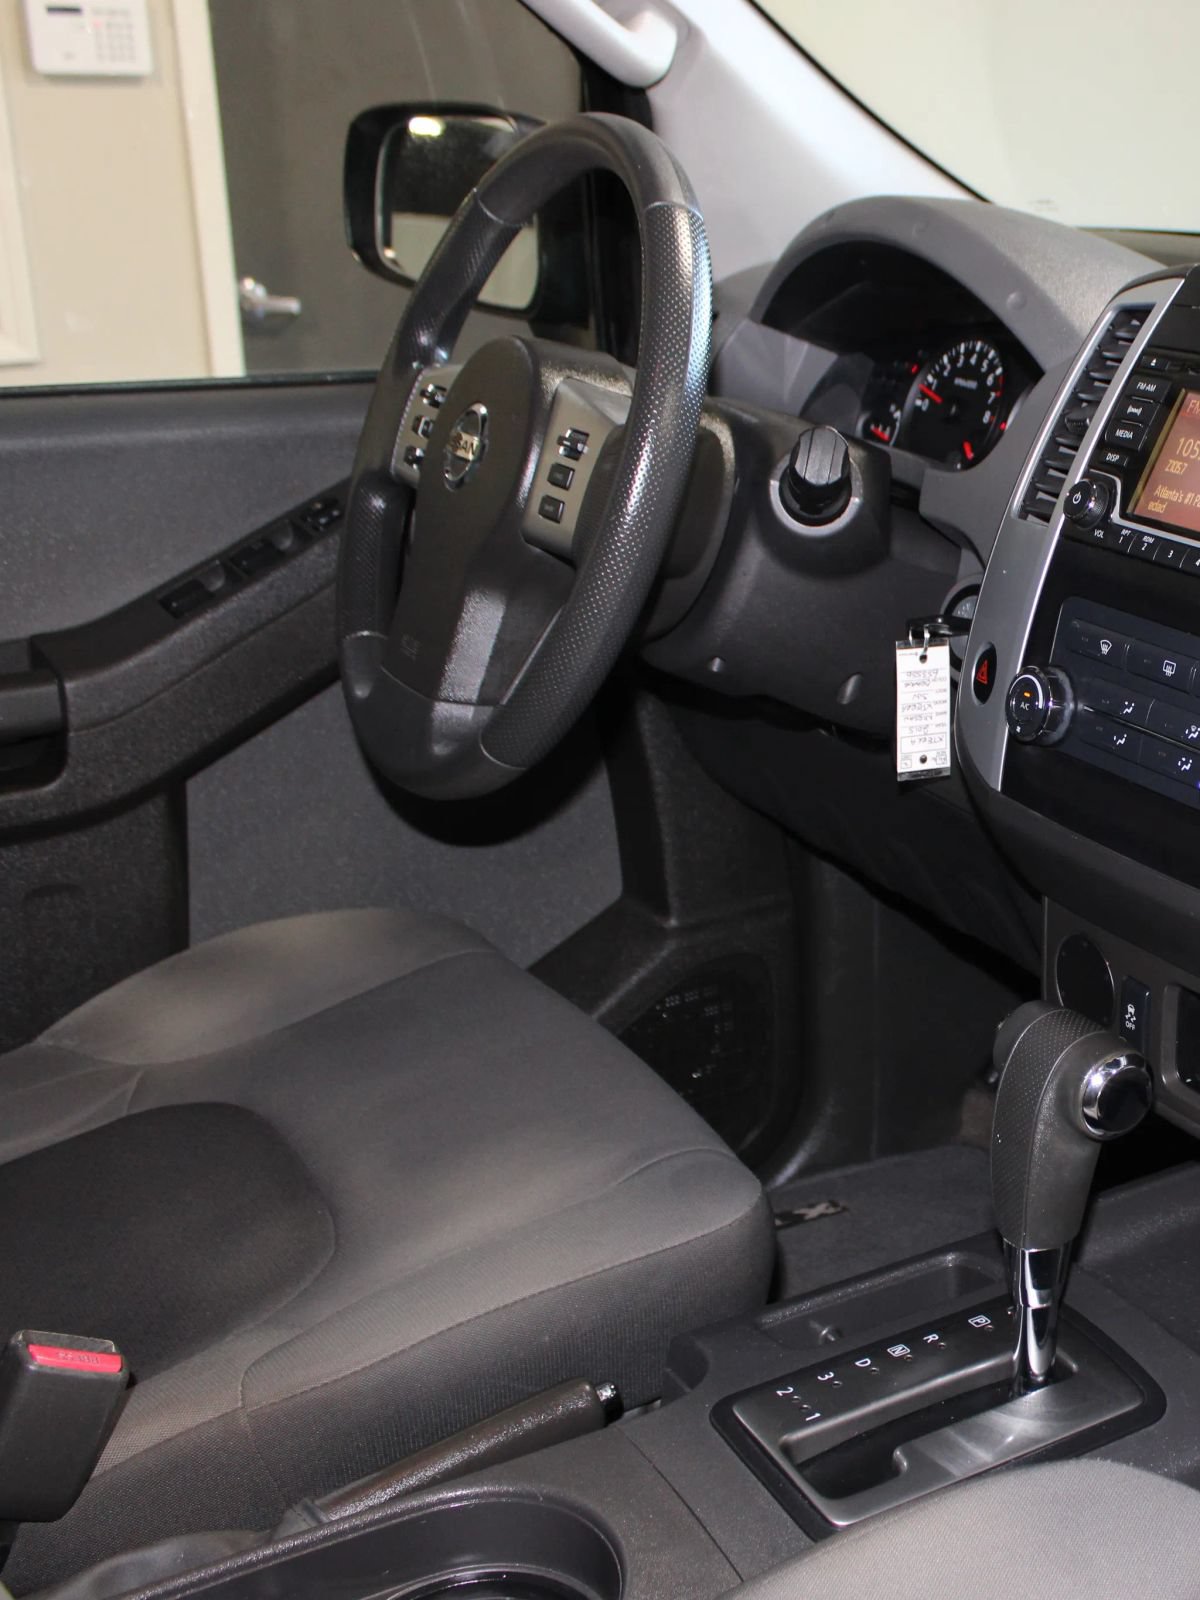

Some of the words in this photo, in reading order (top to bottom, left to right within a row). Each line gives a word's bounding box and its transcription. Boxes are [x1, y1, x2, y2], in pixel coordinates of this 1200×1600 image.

[1116, 428, 1134, 439] MEDIA
[1106, 452, 1119, 462] DISP
[1154, 484, 1184, 503] Atlanta's
[1094, 529, 1104, 538] VOL
[1168, 550, 1174, 558] 3
[1020, 701, 1030, 711] A/C
[1126, 1020, 1136, 1030] OFF
[923, 1333, 938, 1343] R
[855, 1358, 871, 1368] D
[818, 1372, 834, 1382] 3
[776, 1386, 794, 1396] 2
[806, 1412, 821, 1422] 1
